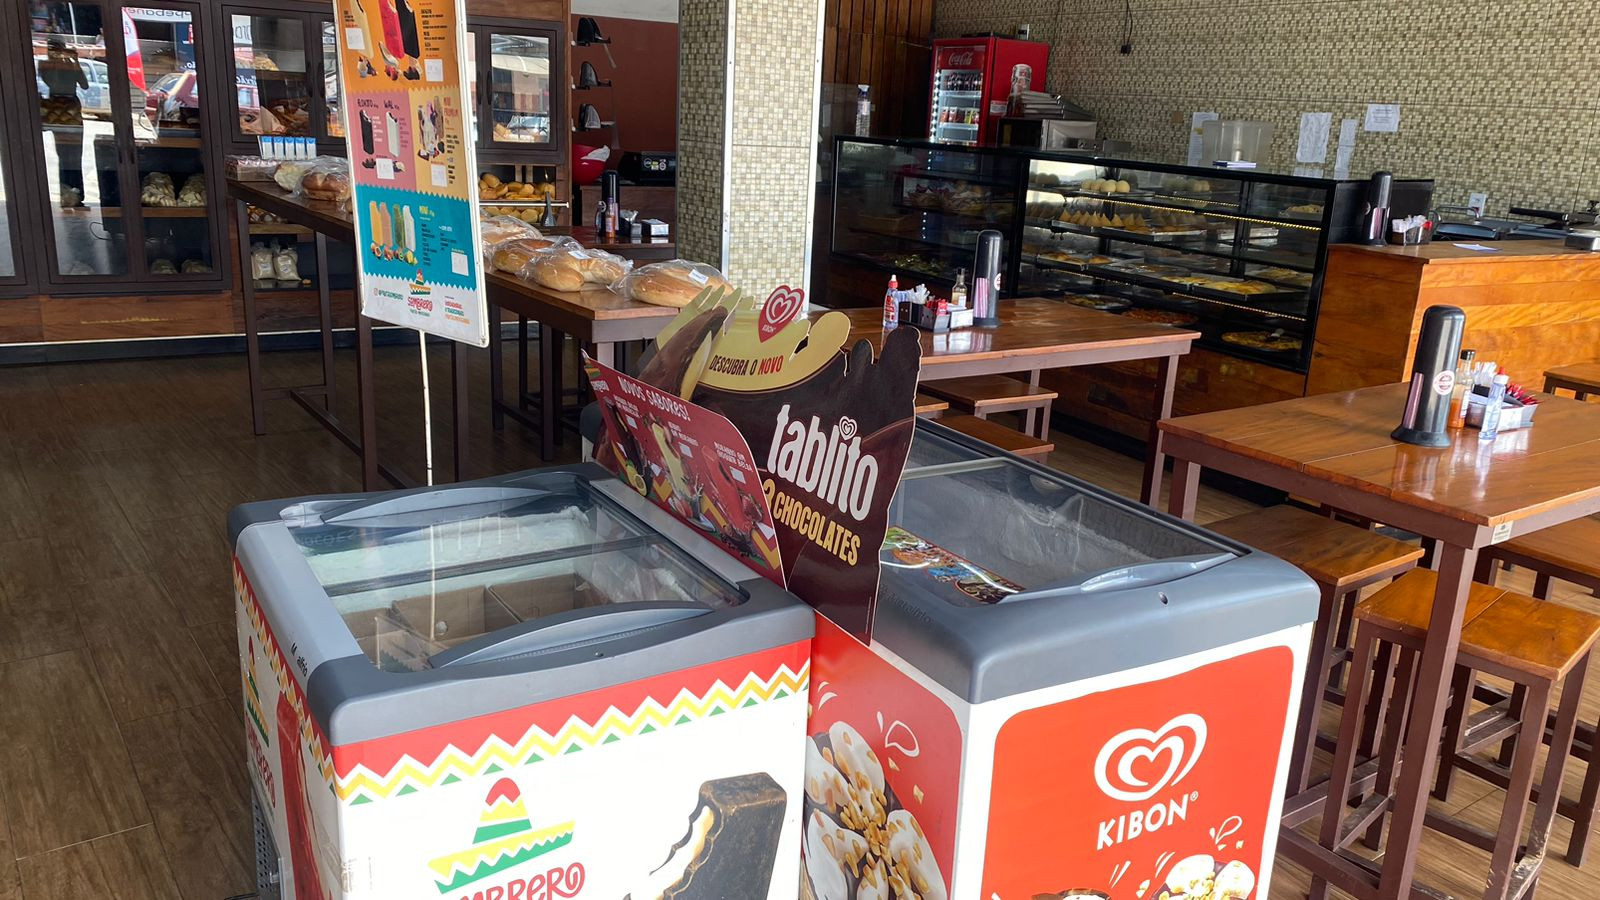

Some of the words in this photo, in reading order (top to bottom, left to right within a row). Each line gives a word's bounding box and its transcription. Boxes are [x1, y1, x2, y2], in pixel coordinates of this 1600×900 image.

[617, 375, 647, 402] NOVOS
[709, 355, 749, 376] DESCUBRA
[750, 359, 758, 376] O
[757, 355, 784, 375] NOVO
[767, 404, 878, 521] tablito
[773, 491, 860, 566] CHOCOLATES
